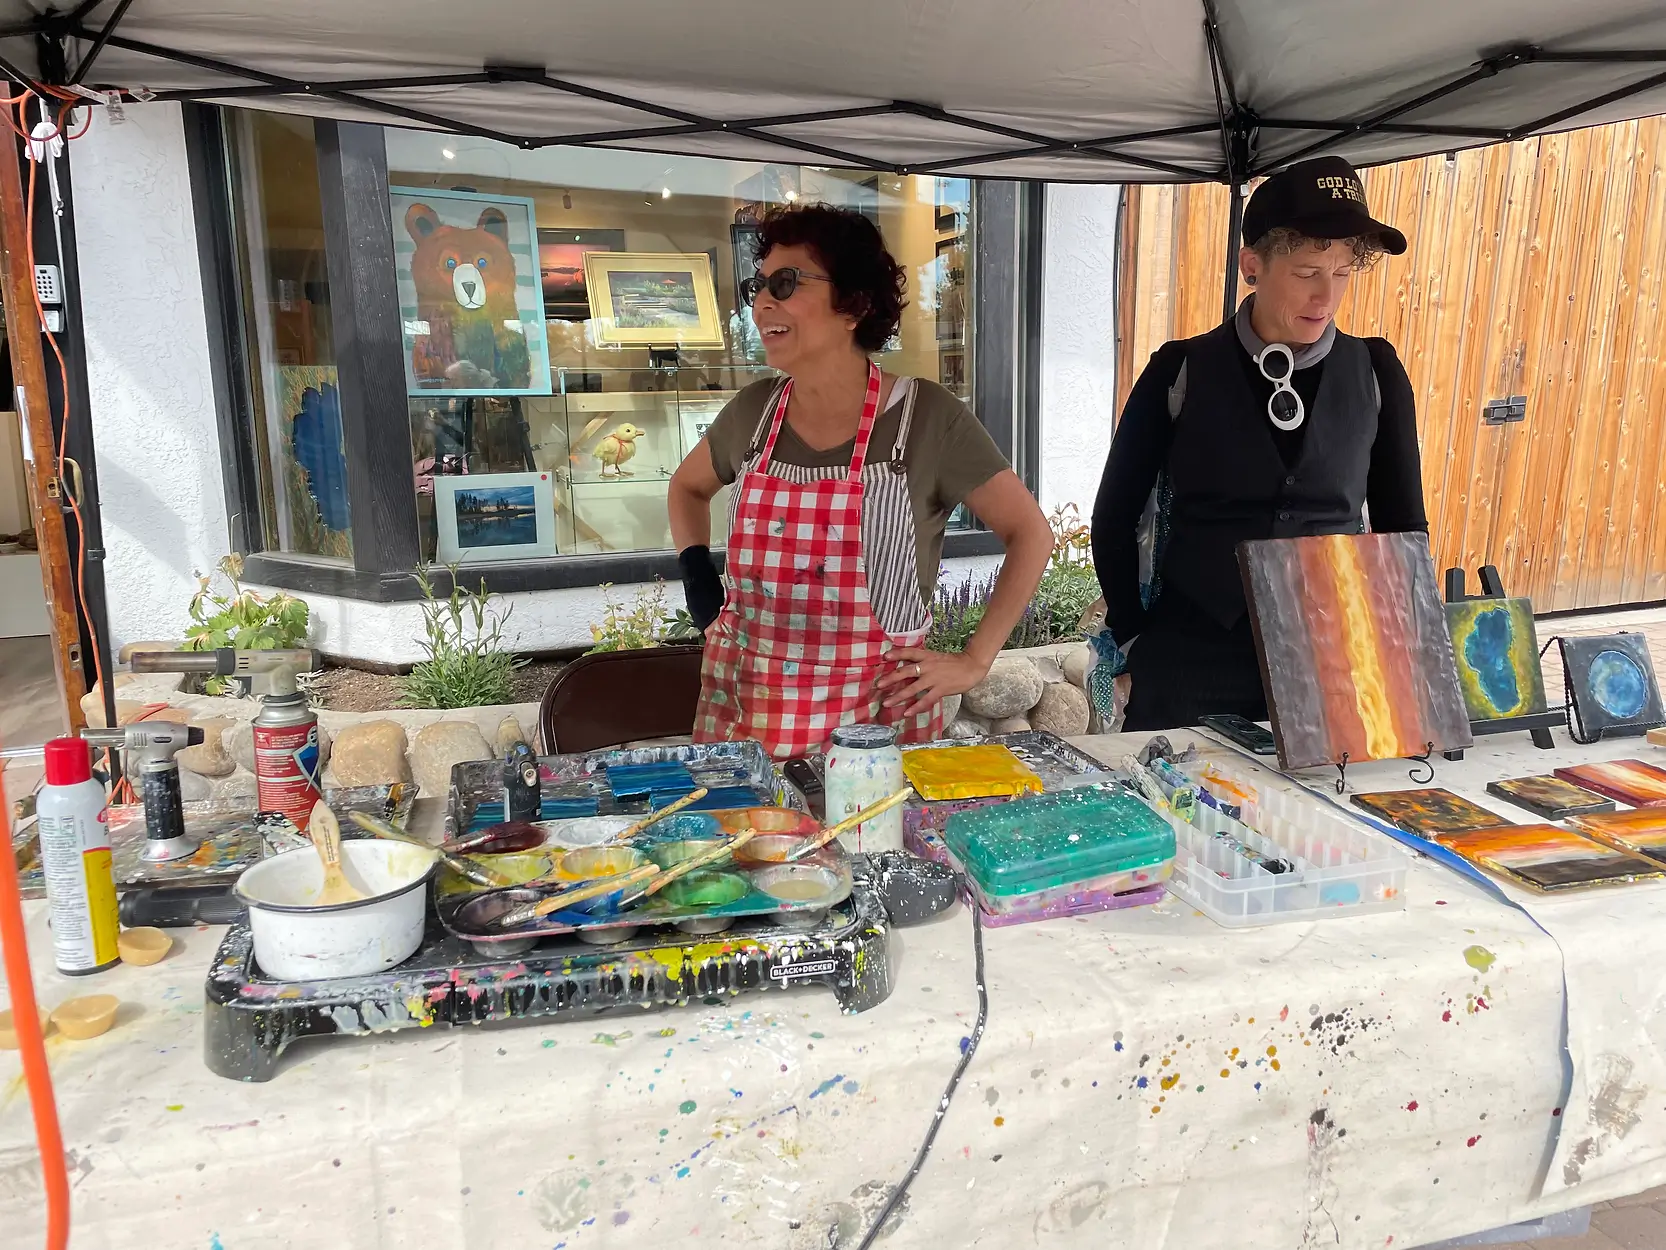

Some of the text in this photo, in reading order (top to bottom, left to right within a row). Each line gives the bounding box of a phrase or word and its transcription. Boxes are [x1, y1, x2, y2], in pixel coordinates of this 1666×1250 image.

[1317, 177, 1343, 189] GOD
[1332, 188, 1342, 198] A
[773, 963, 832, 976] BLACK+DECKER
